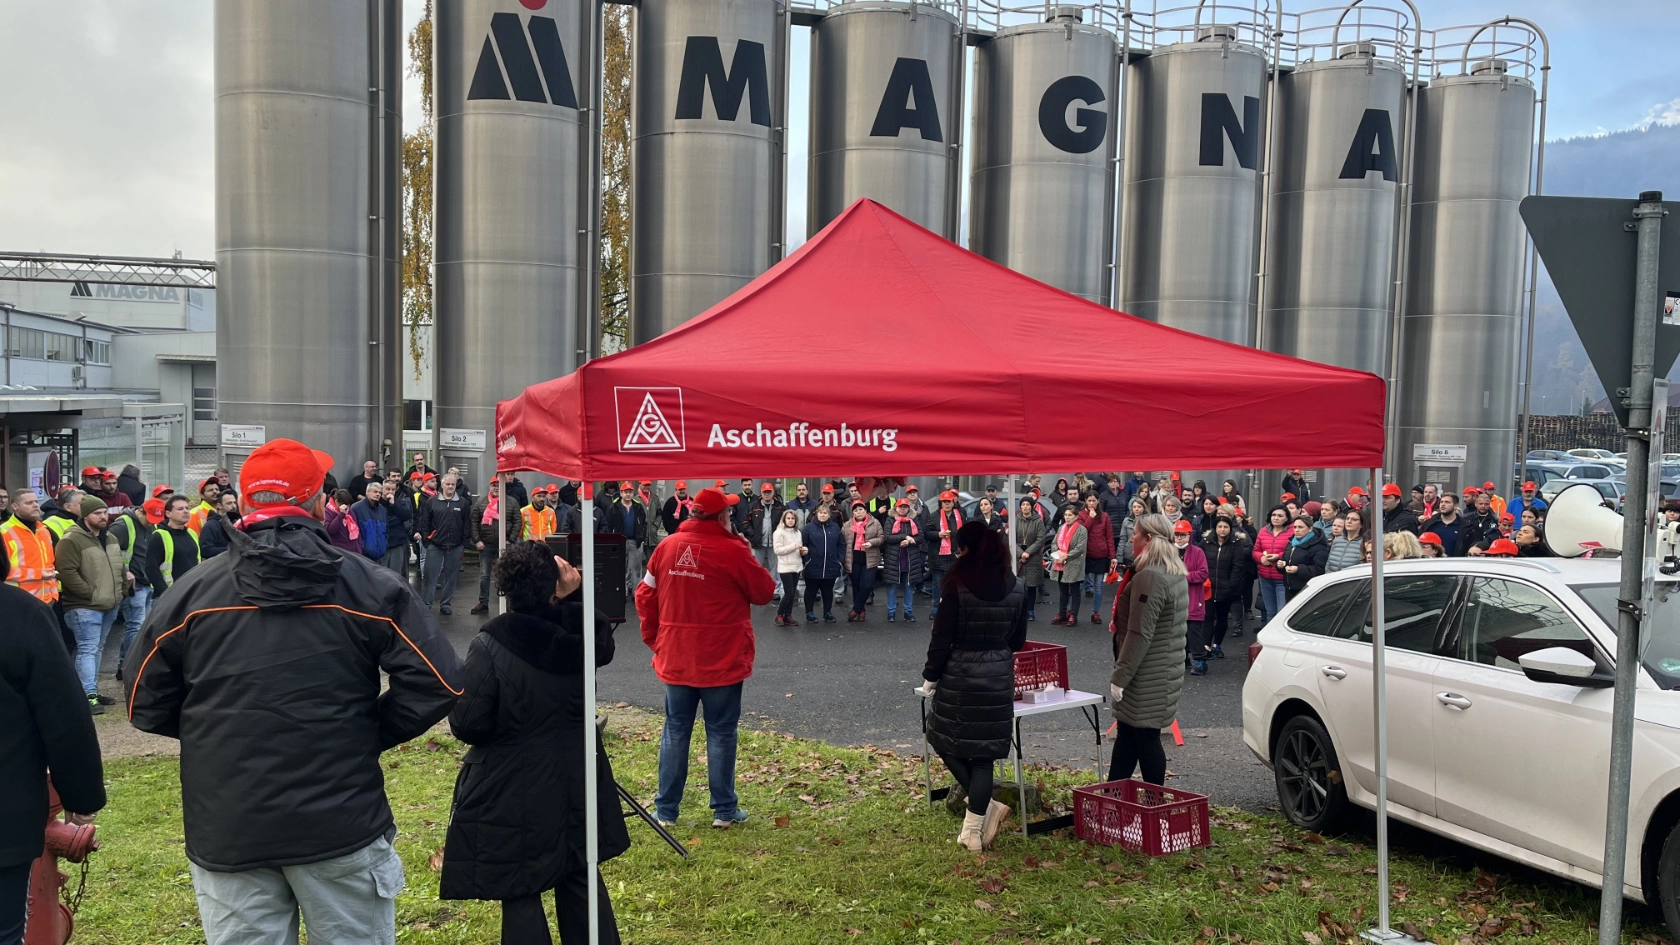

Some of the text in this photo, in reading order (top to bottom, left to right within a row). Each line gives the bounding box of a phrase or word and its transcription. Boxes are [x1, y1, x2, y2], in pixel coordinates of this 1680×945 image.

[95, 282, 180, 301] MAGNA
[231, 431, 242, 439] Silo
[707, 422, 898, 451] Aschaffenburg
[668, 569, 705, 580] Aschaffenburg
